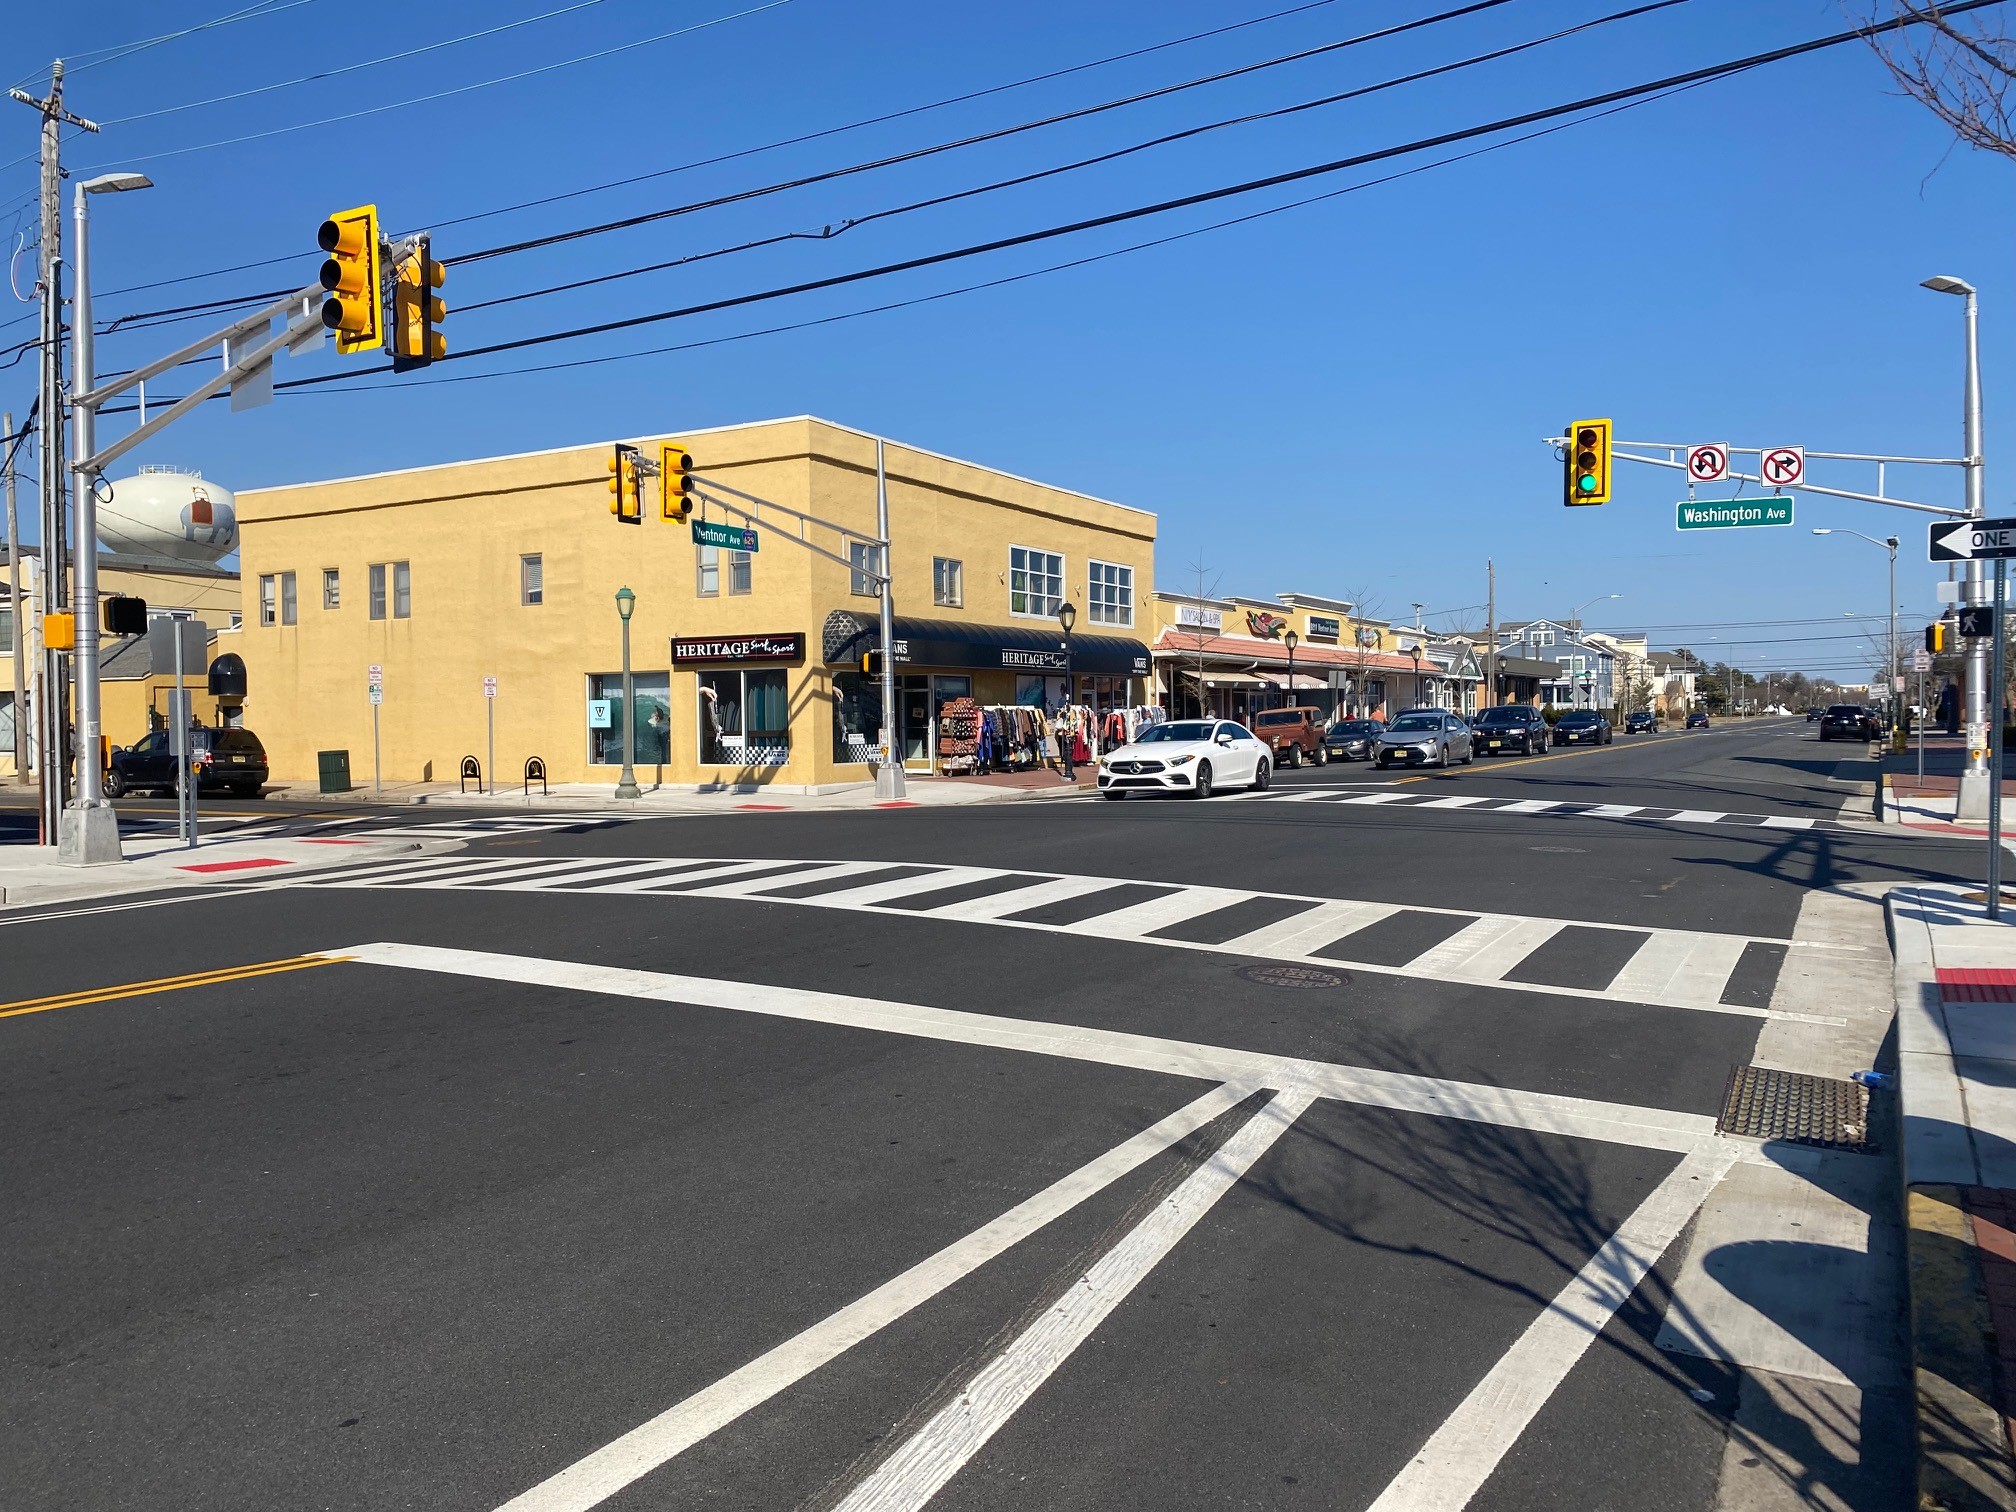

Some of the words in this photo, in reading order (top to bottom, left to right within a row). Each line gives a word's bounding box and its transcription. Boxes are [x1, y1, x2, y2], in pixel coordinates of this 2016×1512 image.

[1684, 505, 1761, 525] Washington
[1766, 507, 1786, 519] Ave
[695, 525, 726, 543] Ventnor
[729, 534, 741, 545] Ave
[1972, 531, 2011, 547] ONE
[676, 642, 750, 657] HERITAGE
[750, 639, 769, 651] Surf
[772, 643, 795, 655] Sport
[893, 640, 908, 654] ANS
[1002, 652, 1044, 665] HERITAGE
[1133, 657, 1147, 669] VANS
